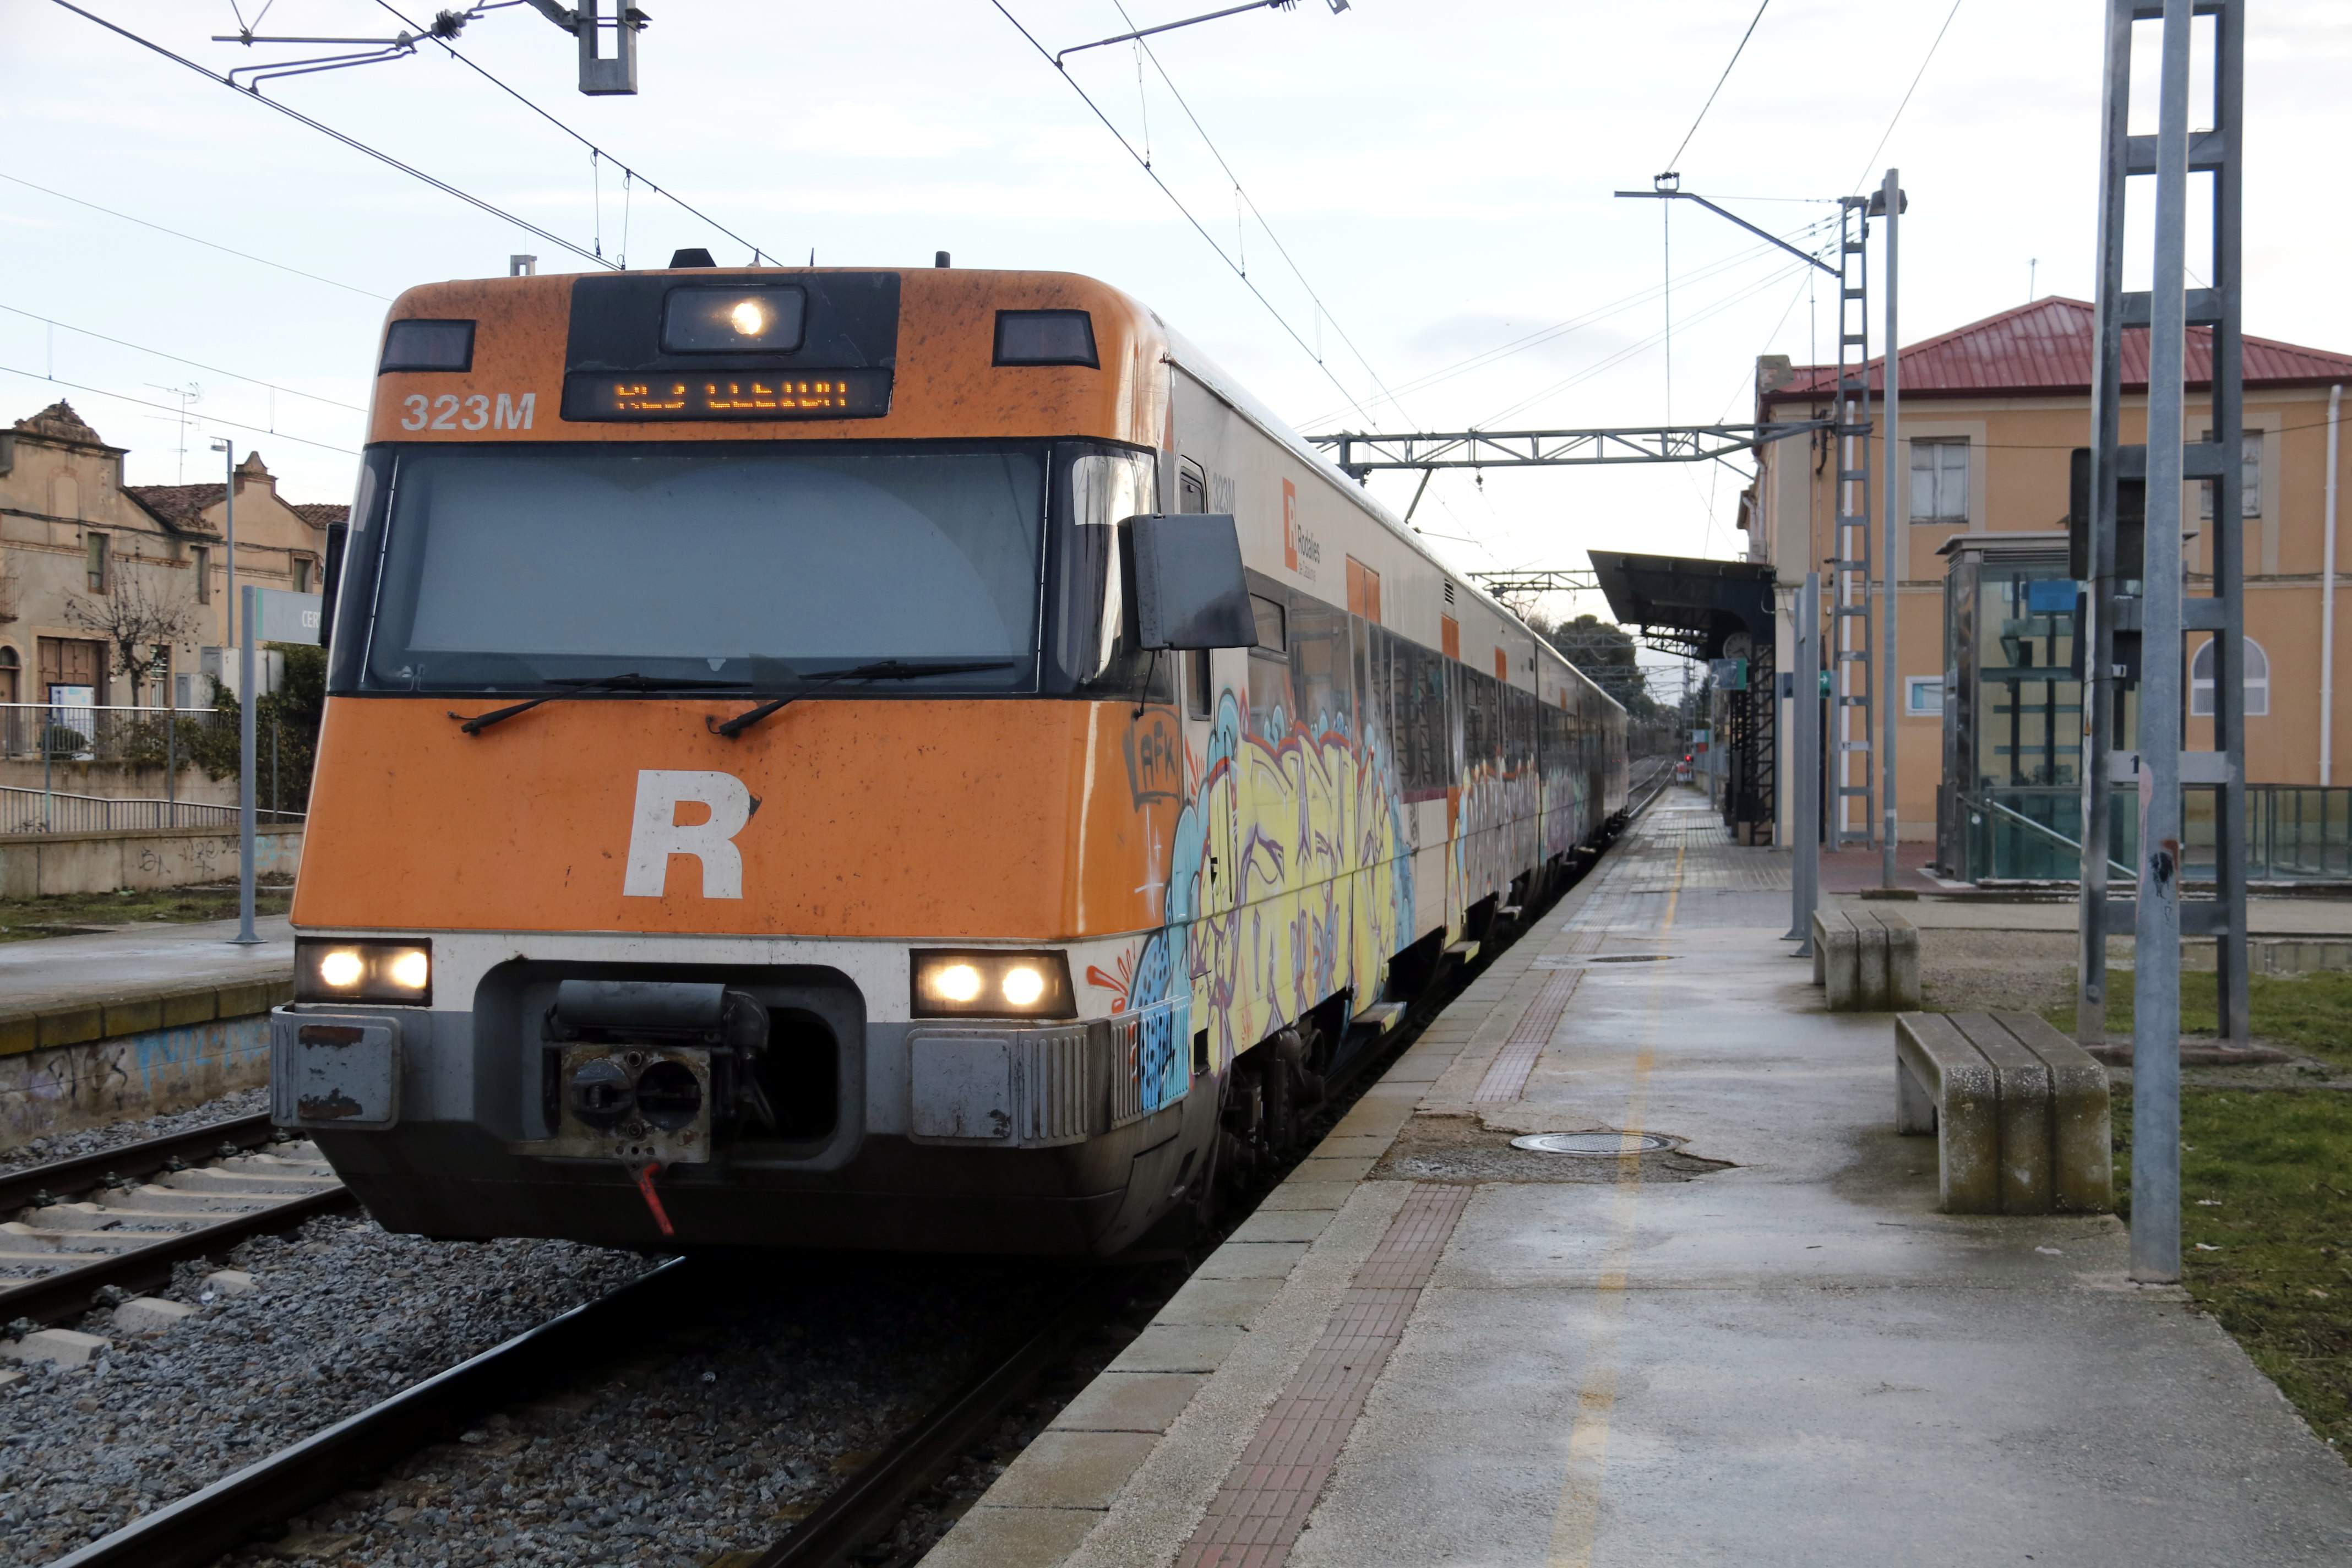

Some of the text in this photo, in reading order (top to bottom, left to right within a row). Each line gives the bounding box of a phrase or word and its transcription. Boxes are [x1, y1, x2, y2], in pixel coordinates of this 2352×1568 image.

[401, 393, 536, 431] 323M
[1213, 472, 1235, 518] 323M
[1288, 494, 1297, 551] R
[1297, 524, 1321, 564] Rodalies
[1711, 673, 1720, 688] 2
[1140, 721, 1176, 790] AFK
[623, 770, 750, 899] R
